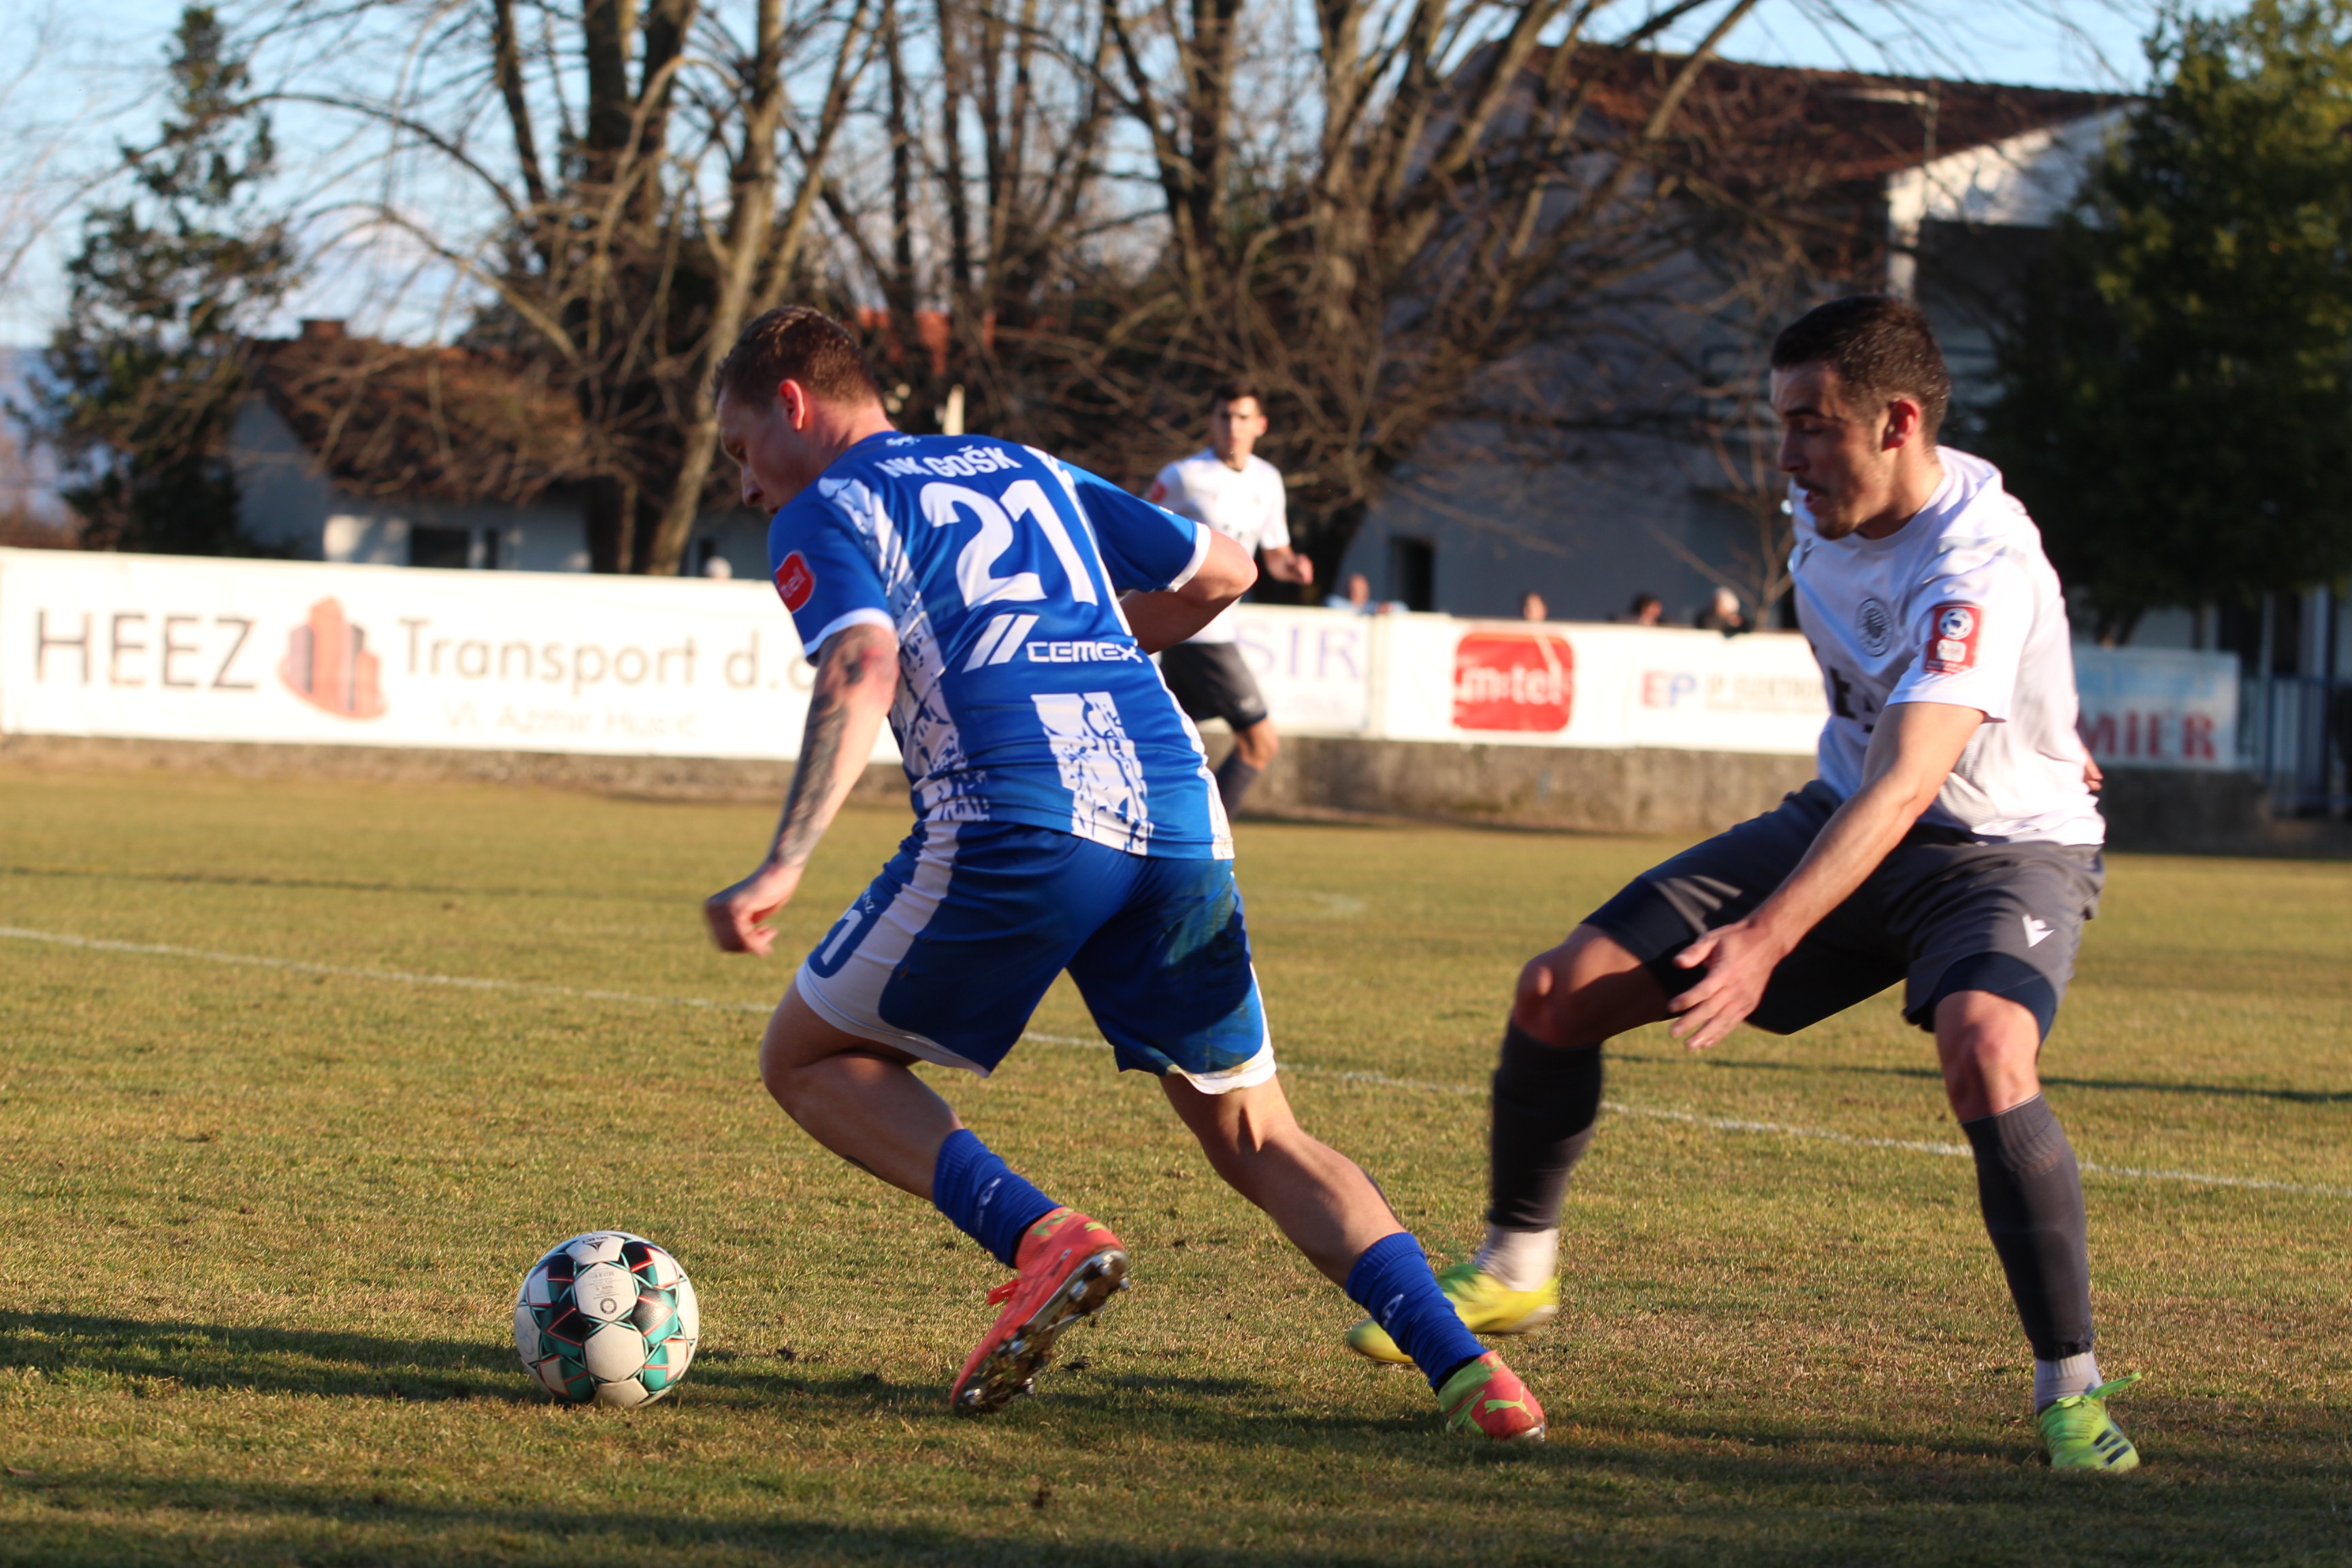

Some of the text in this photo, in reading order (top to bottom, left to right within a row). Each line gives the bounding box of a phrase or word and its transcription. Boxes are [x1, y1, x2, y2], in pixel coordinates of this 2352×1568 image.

[874, 444, 1023, 478] NK GOŠK
[920, 479, 1098, 610] 21
[36, 607, 259, 690] HEEZ
[399, 616, 698, 696] Transport
[1026, 641, 1143, 664] CEMEX
